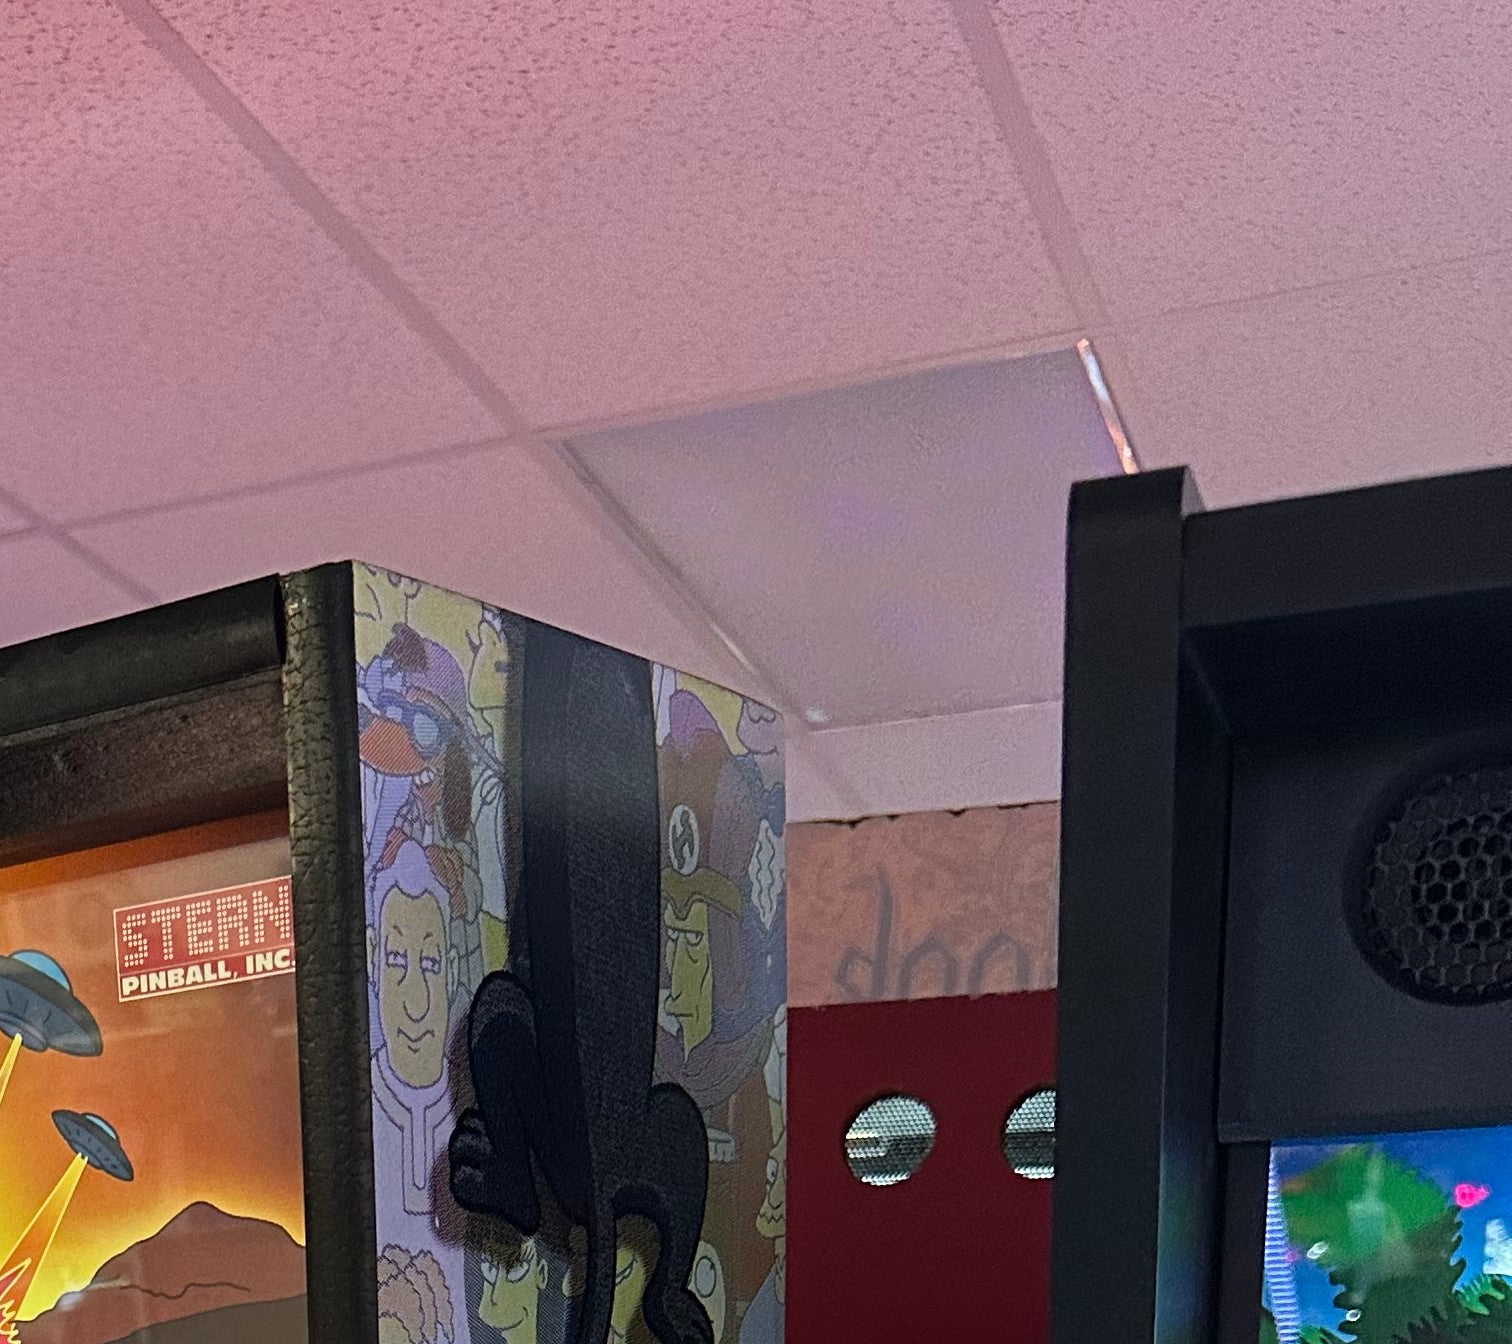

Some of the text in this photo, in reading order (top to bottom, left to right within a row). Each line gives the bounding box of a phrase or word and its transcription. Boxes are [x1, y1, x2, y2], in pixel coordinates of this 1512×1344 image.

[121, 884, 291, 968] STERN
[120, 948, 296, 996] PINBALL, INC.
